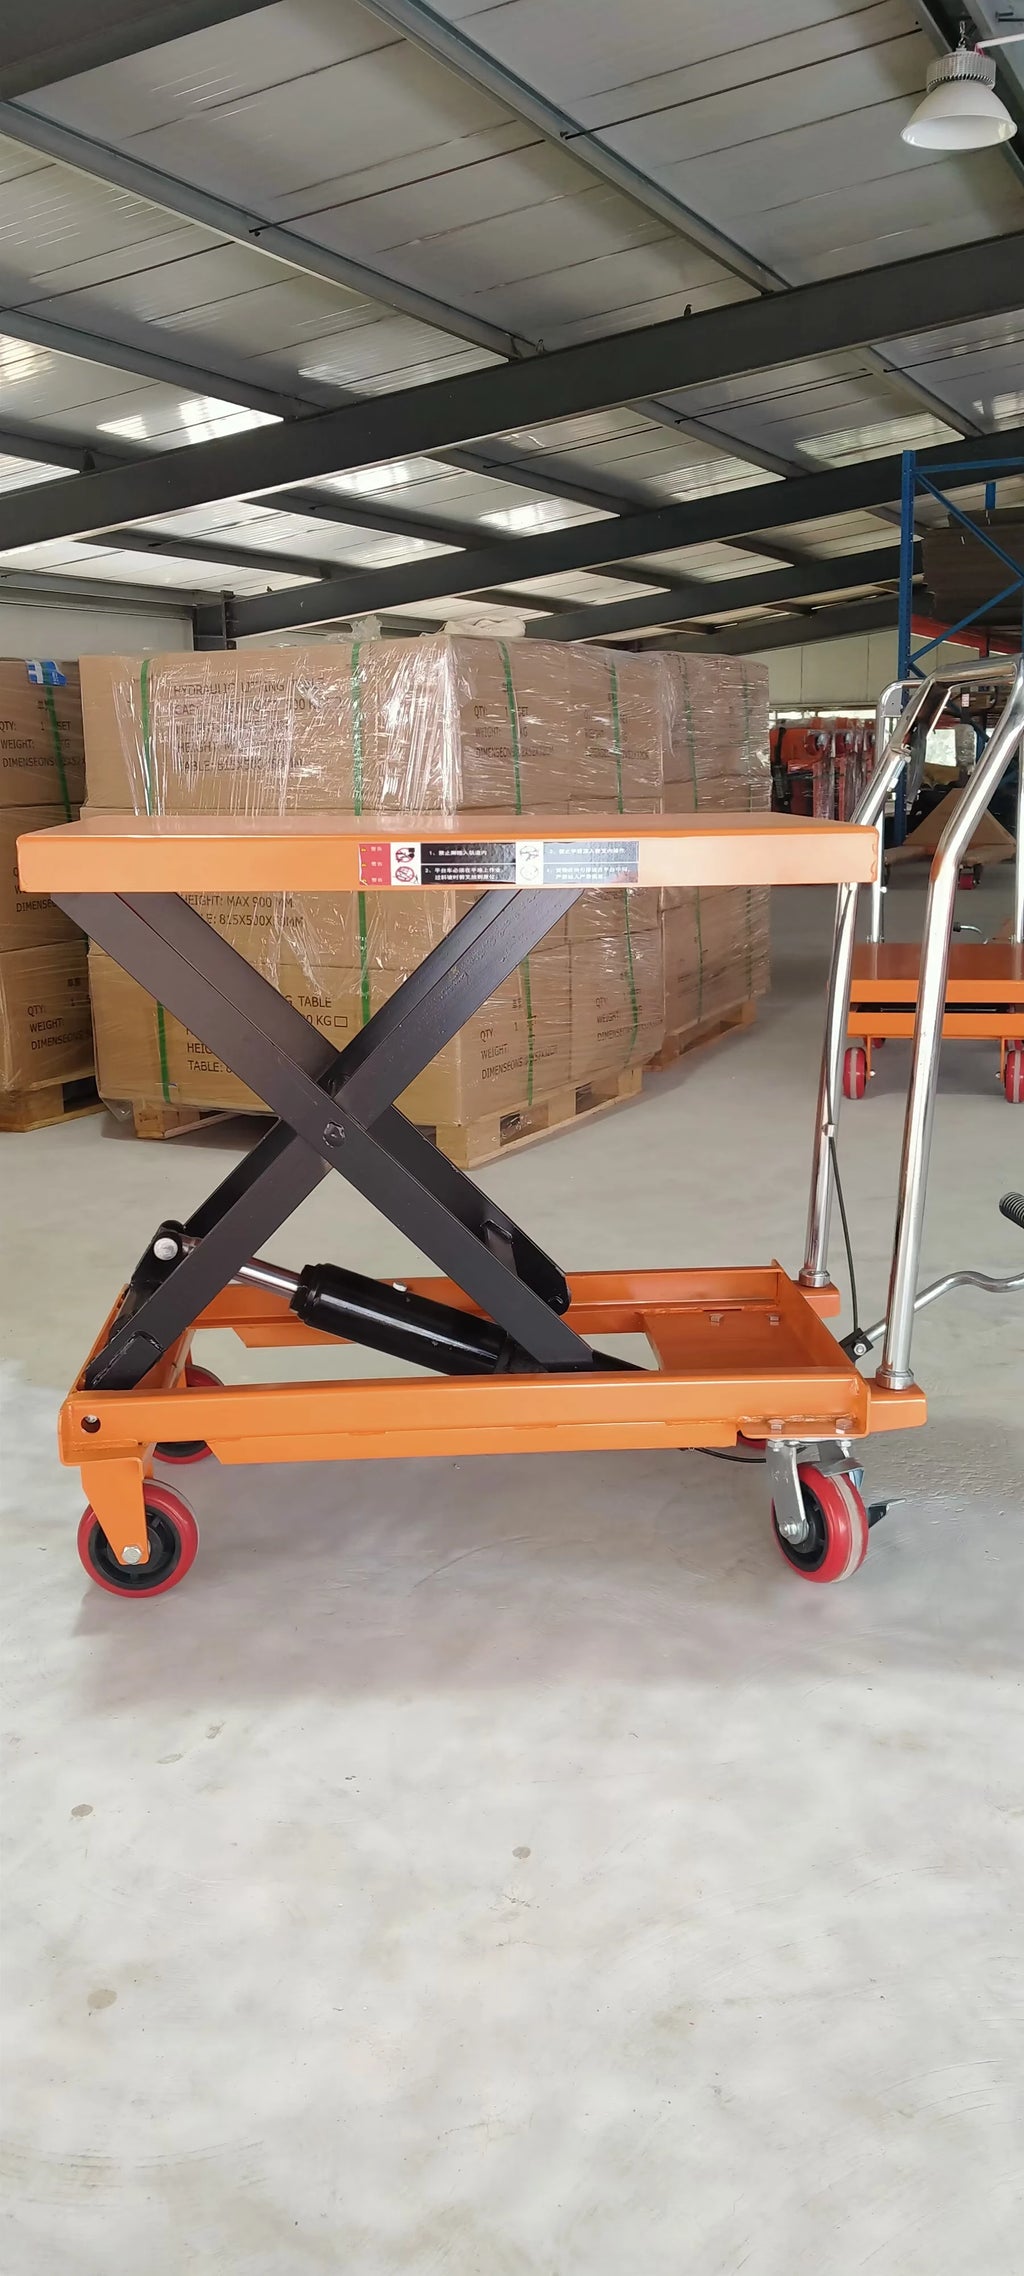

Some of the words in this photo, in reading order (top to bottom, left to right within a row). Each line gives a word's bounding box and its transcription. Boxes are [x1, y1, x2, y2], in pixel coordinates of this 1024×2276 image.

[1, 738, 35, 750] WEIGHT:
[226, 896, 250, 908] MAX
[298, 995, 332, 1008] TABLE
[316, 1014, 333, 1027] KG
[187, 1059, 223, 1073] TABLE:
